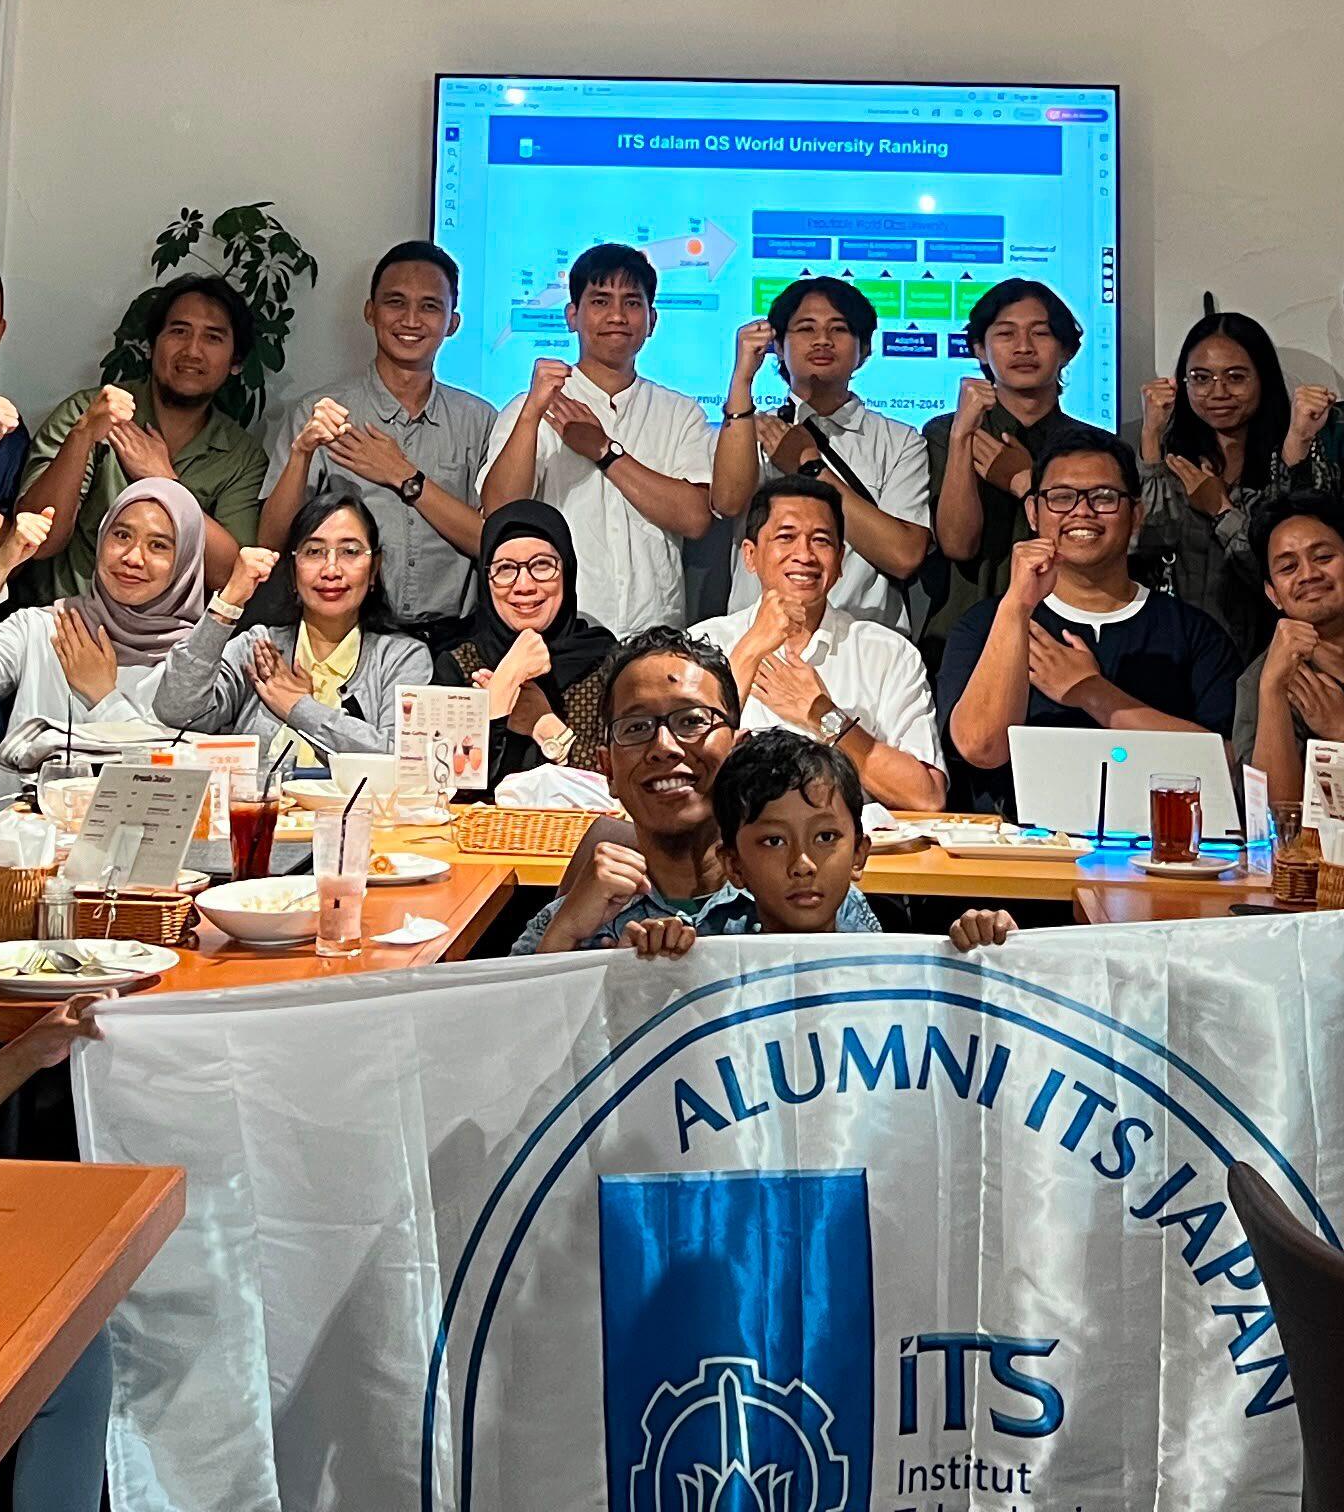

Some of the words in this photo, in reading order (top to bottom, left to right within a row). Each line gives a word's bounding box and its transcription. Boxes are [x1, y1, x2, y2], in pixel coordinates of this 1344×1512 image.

[617, 134, 645, 149] ITS
[649, 135, 700, 150] dalam
[705, 135, 731, 151] QS
[735, 136, 785, 151] World
[789, 137, 874, 157] University
[879, 139, 949, 158] Ranking
[890, 398, 946, 410] 2021-2045
[674, 1024, 1011, 1154] ALUMNI
[1024, 1068, 1154, 1180] ITS
[1130, 1163, 1296, 1419] JAPAN
[898, 1454, 1032, 1495] Institut
